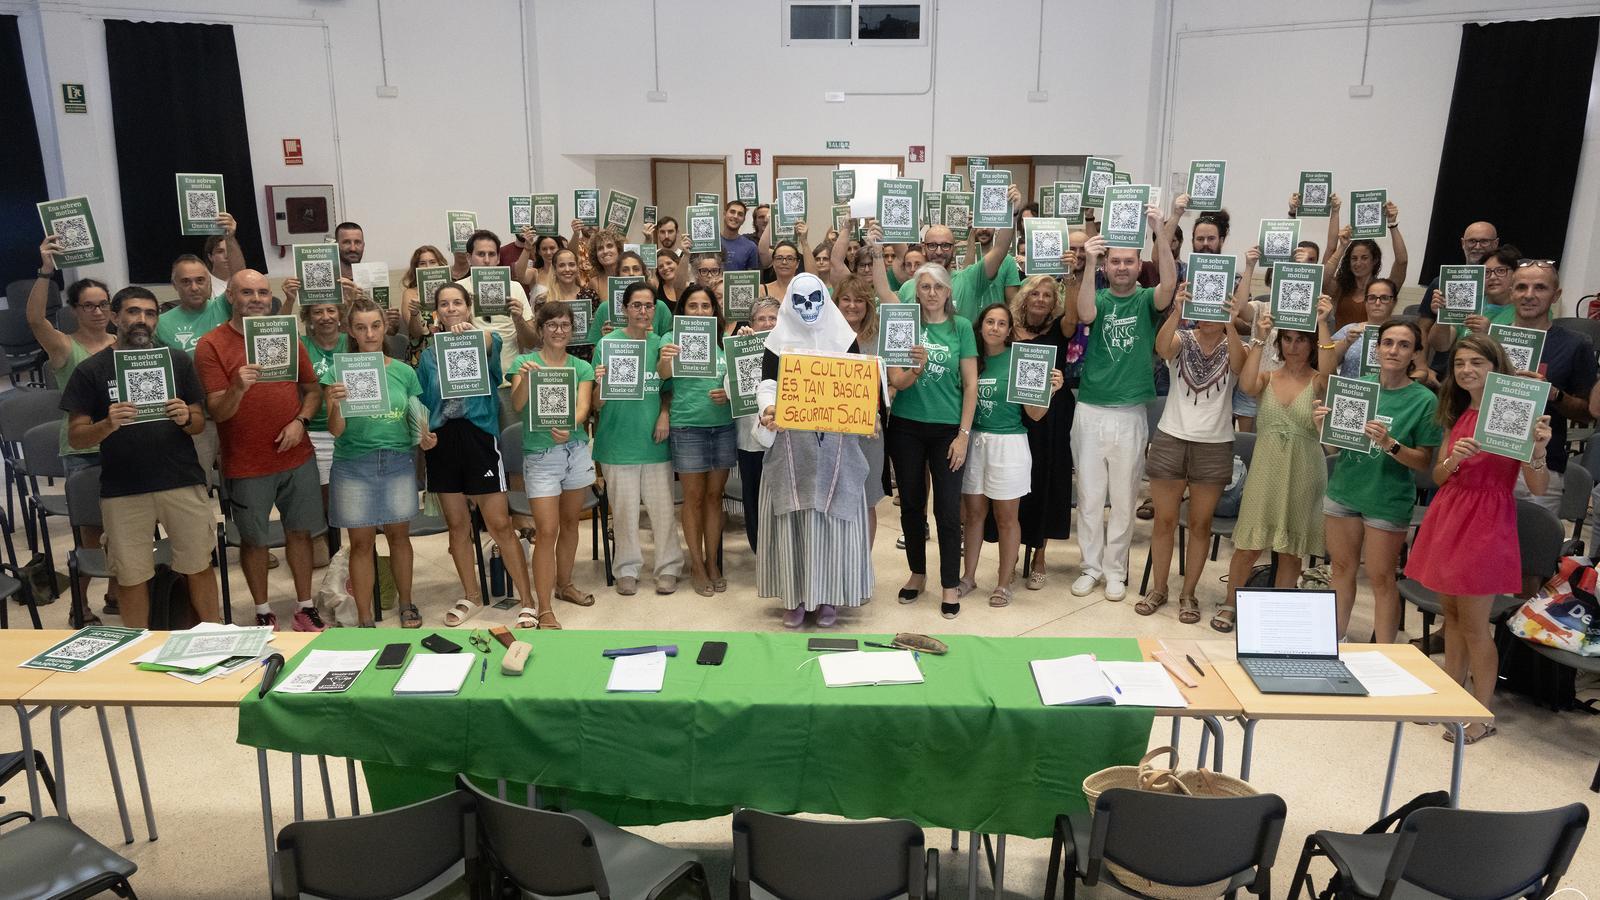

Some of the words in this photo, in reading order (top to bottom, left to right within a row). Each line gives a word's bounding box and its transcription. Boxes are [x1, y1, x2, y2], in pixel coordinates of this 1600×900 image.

[1280, 315, 1307, 323] Uneix-te!
[1512, 330, 1536, 340] sobren
[733, 339, 748, 348] Ens
[748, 337, 764, 345] sobr
[1503, 336, 1529, 345] motius
[742, 344, 763, 353] motiu
[784, 358, 802, 375] LA
[810, 361, 872, 380] CULTURA
[928, 362, 945, 374] TOCA
[782, 377, 798, 392] ES
[803, 379, 825, 396] TAN
[833, 380, 869, 400] BÀSICA
[1337, 380, 1348, 388] Ens
[1349, 384, 1371, 392] sobren
[1496, 377, 1510, 385] Ens
[1512, 381, 1540, 391] sobren
[1342, 389, 1363, 397] motius
[1502, 387, 1530, 397] motius
[782, 394, 799, 402] COM
[137, 406, 166, 415] neix-te
[783, 406, 835, 423] SEGURITAT
[1332, 432, 1361, 442] Uneix-te!
[1486, 437, 1522, 451] Uneix-te!
